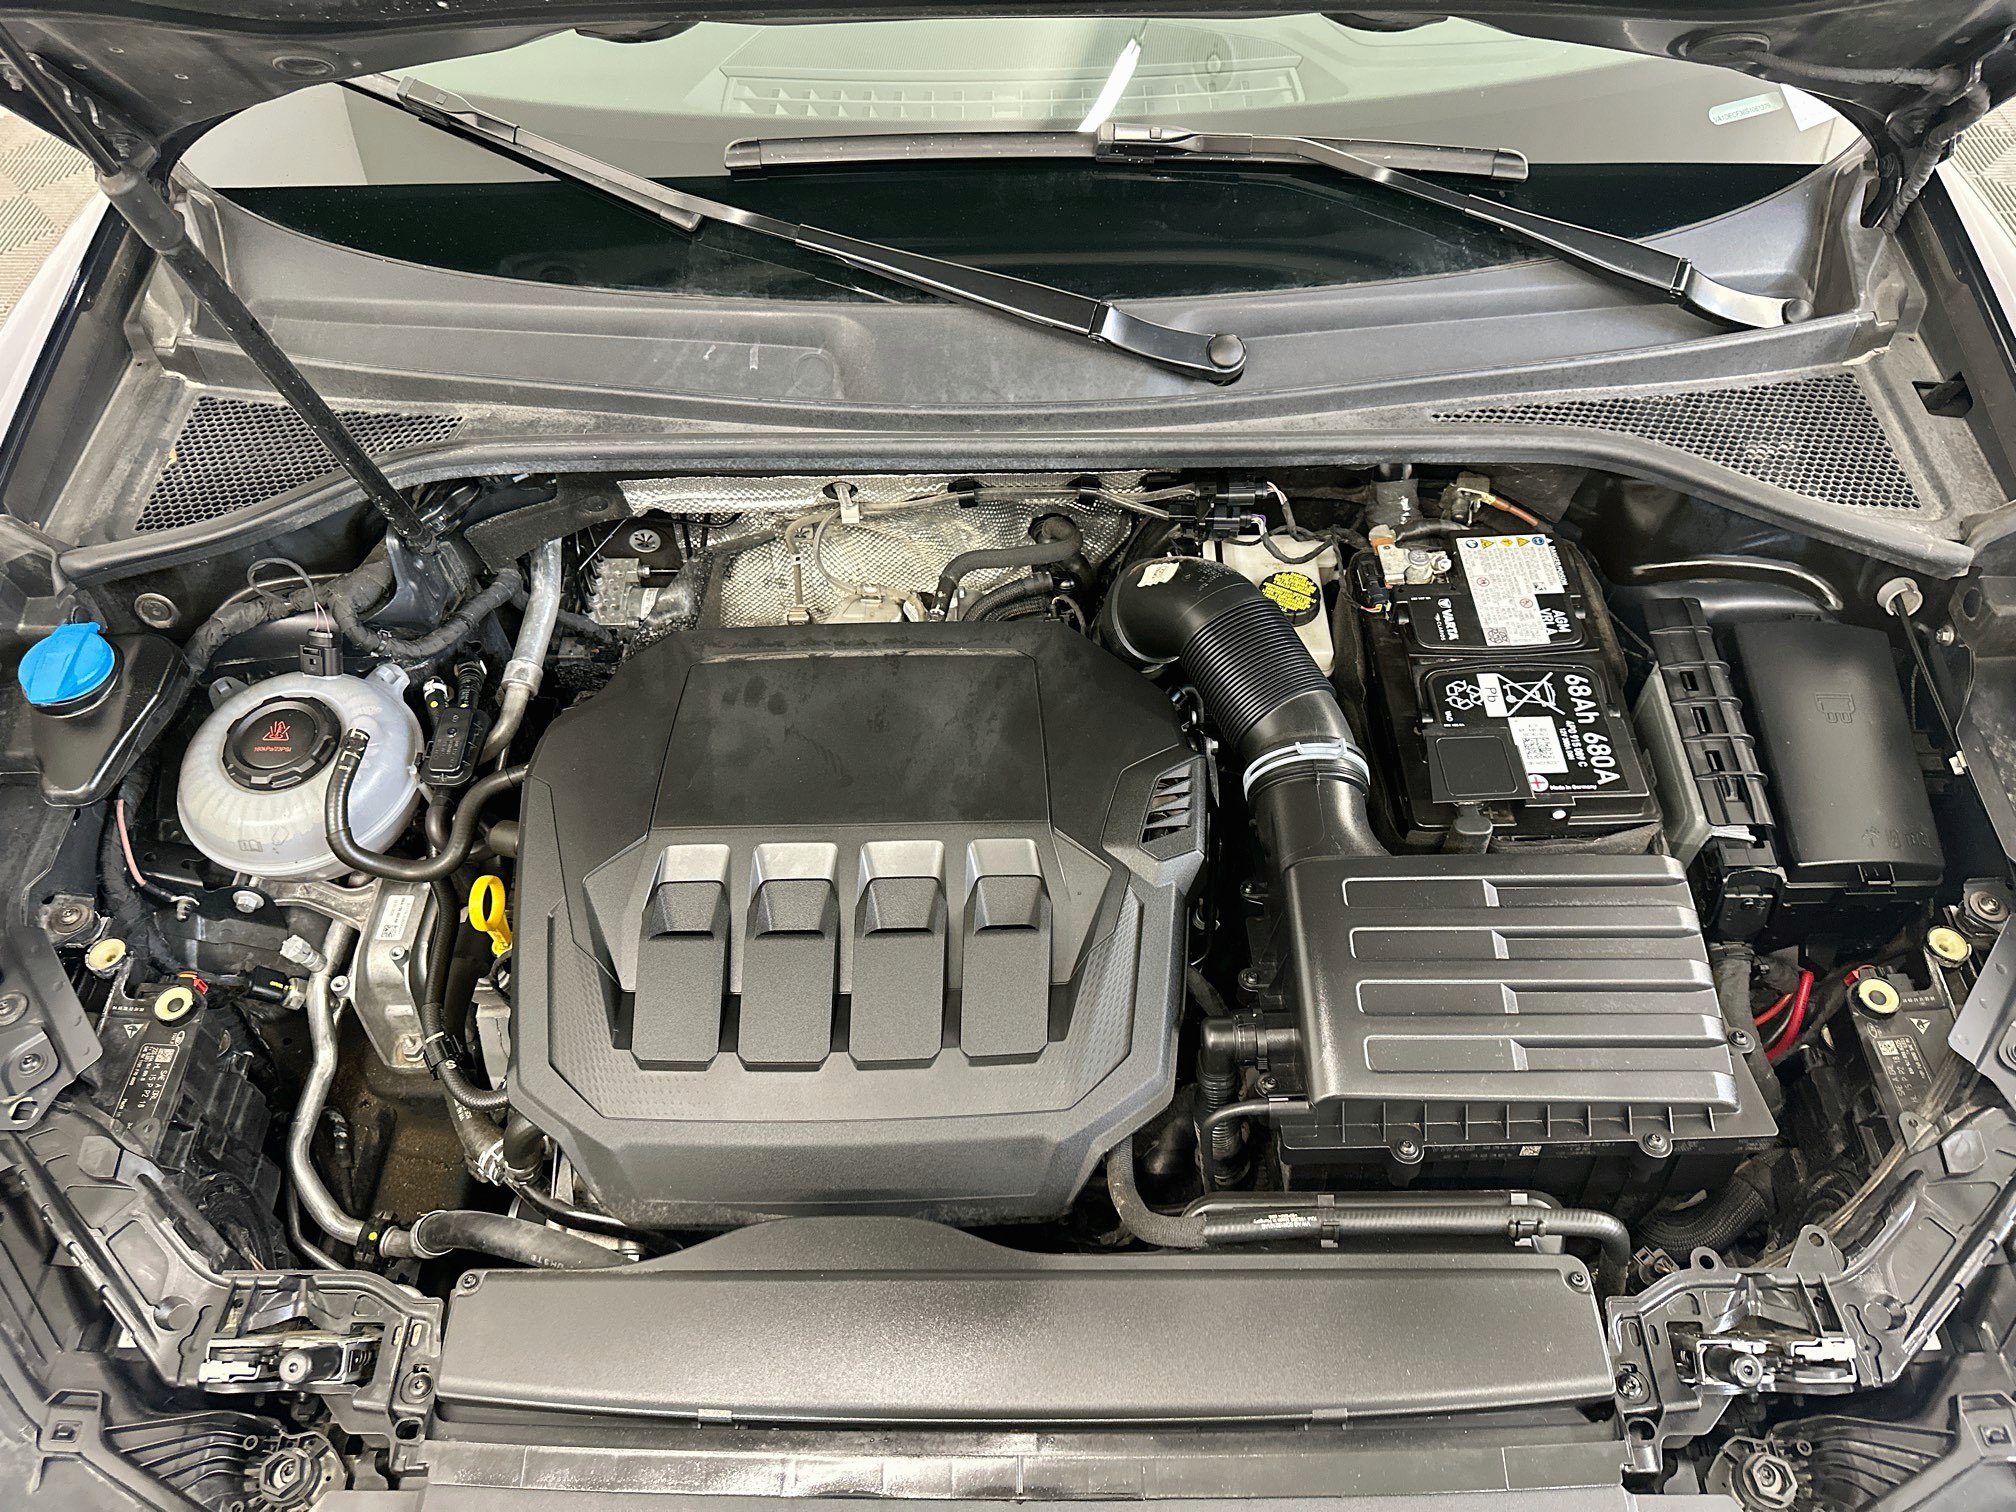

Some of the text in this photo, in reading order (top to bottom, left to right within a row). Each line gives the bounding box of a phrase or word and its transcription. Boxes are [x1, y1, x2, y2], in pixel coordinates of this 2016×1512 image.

[1436, 620, 1446, 641] CLARIOS
[1441, 608, 1460, 640] VARTA
[1551, 609, 1572, 633] AGM
[1484, 687, 1498, 702] Pb
[1564, 674, 1620, 785] 68Ah 680A
